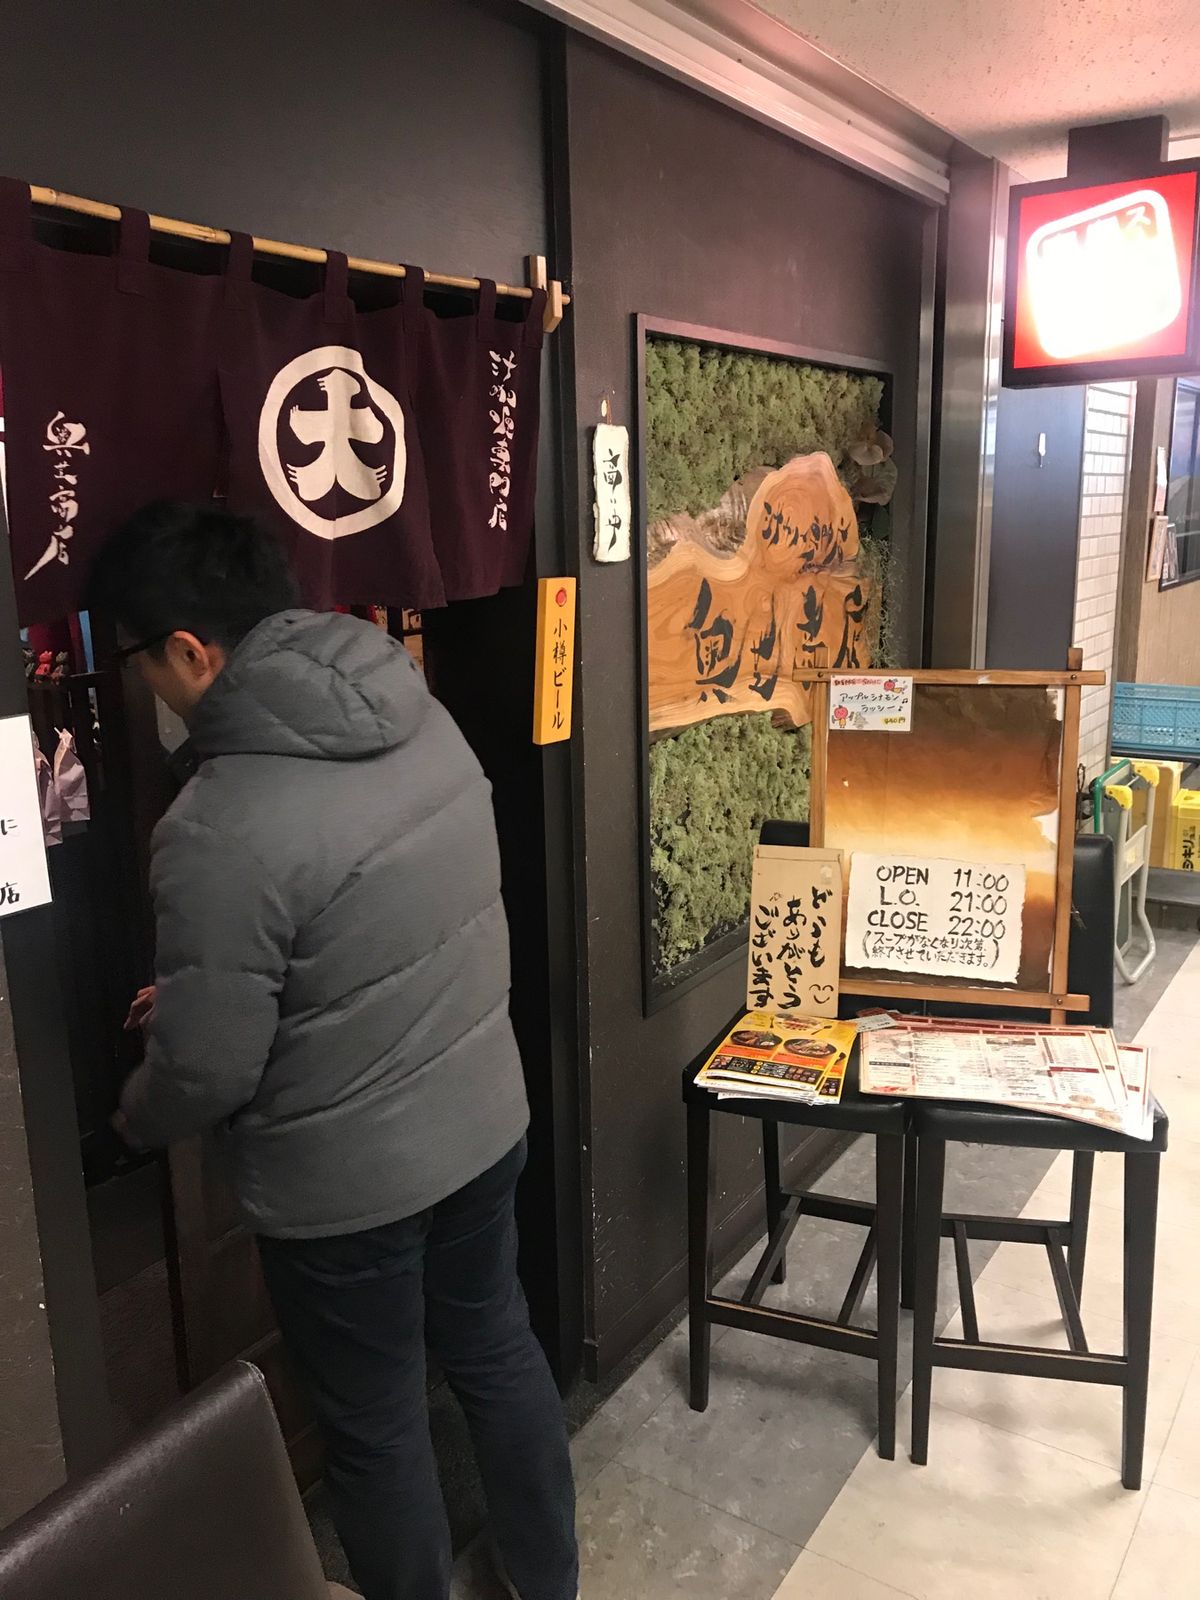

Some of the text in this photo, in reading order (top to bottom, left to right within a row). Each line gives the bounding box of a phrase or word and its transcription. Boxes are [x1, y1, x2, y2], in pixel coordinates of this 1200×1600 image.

[603, 448, 623, 552] 商い中
[552, 618, 568, 730] 小樽ビール
[840, 692, 900, 702] アップルシナモン
[861, 704, 896, 713] ラッシー
[876, 865, 1010, 893] OPEN 11:00
[880, 886, 1008, 916] L.O. 21:00
[776, 895, 808, 1010] ありがとう
[808, 886, 833, 968] どうも
[867, 909, 1006, 941] CLOSE 22:00
[748, 904, 780, 1009] ございます
